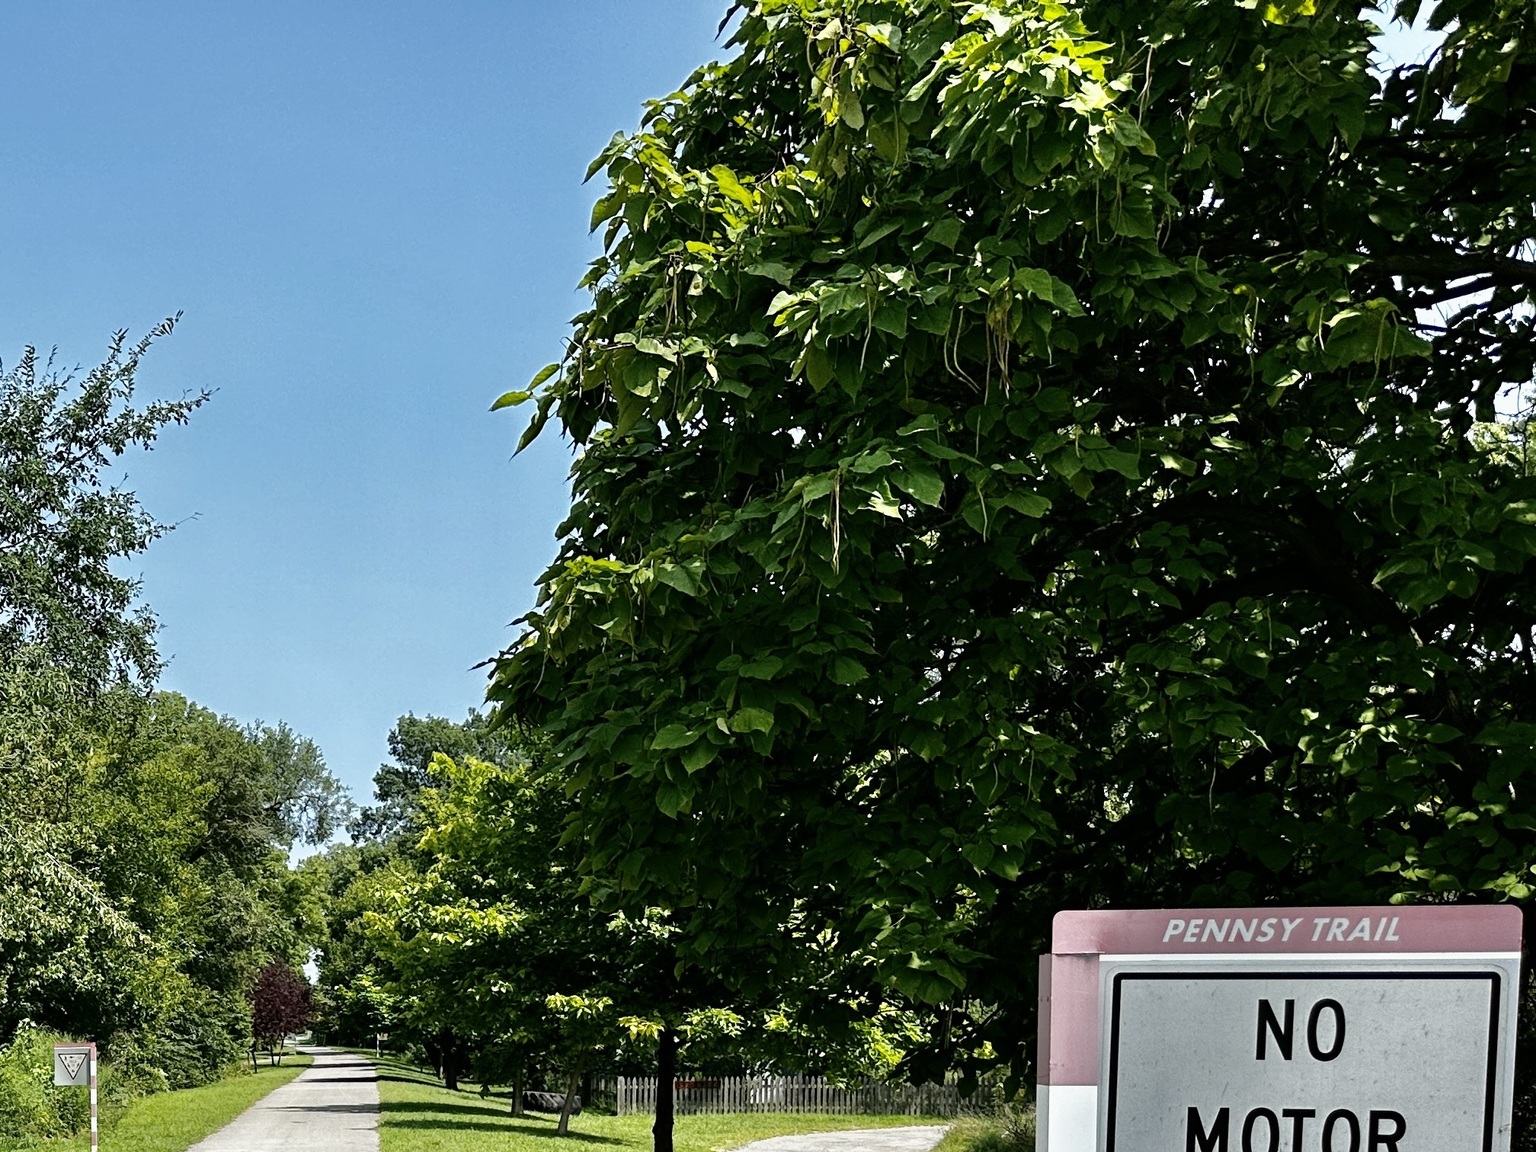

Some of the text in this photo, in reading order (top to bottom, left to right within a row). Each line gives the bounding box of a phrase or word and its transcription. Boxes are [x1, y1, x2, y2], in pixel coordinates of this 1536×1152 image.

[1162, 916, 1401, 943] PENNSY TRAIL
[1255, 998, 1347, 1062] NO
